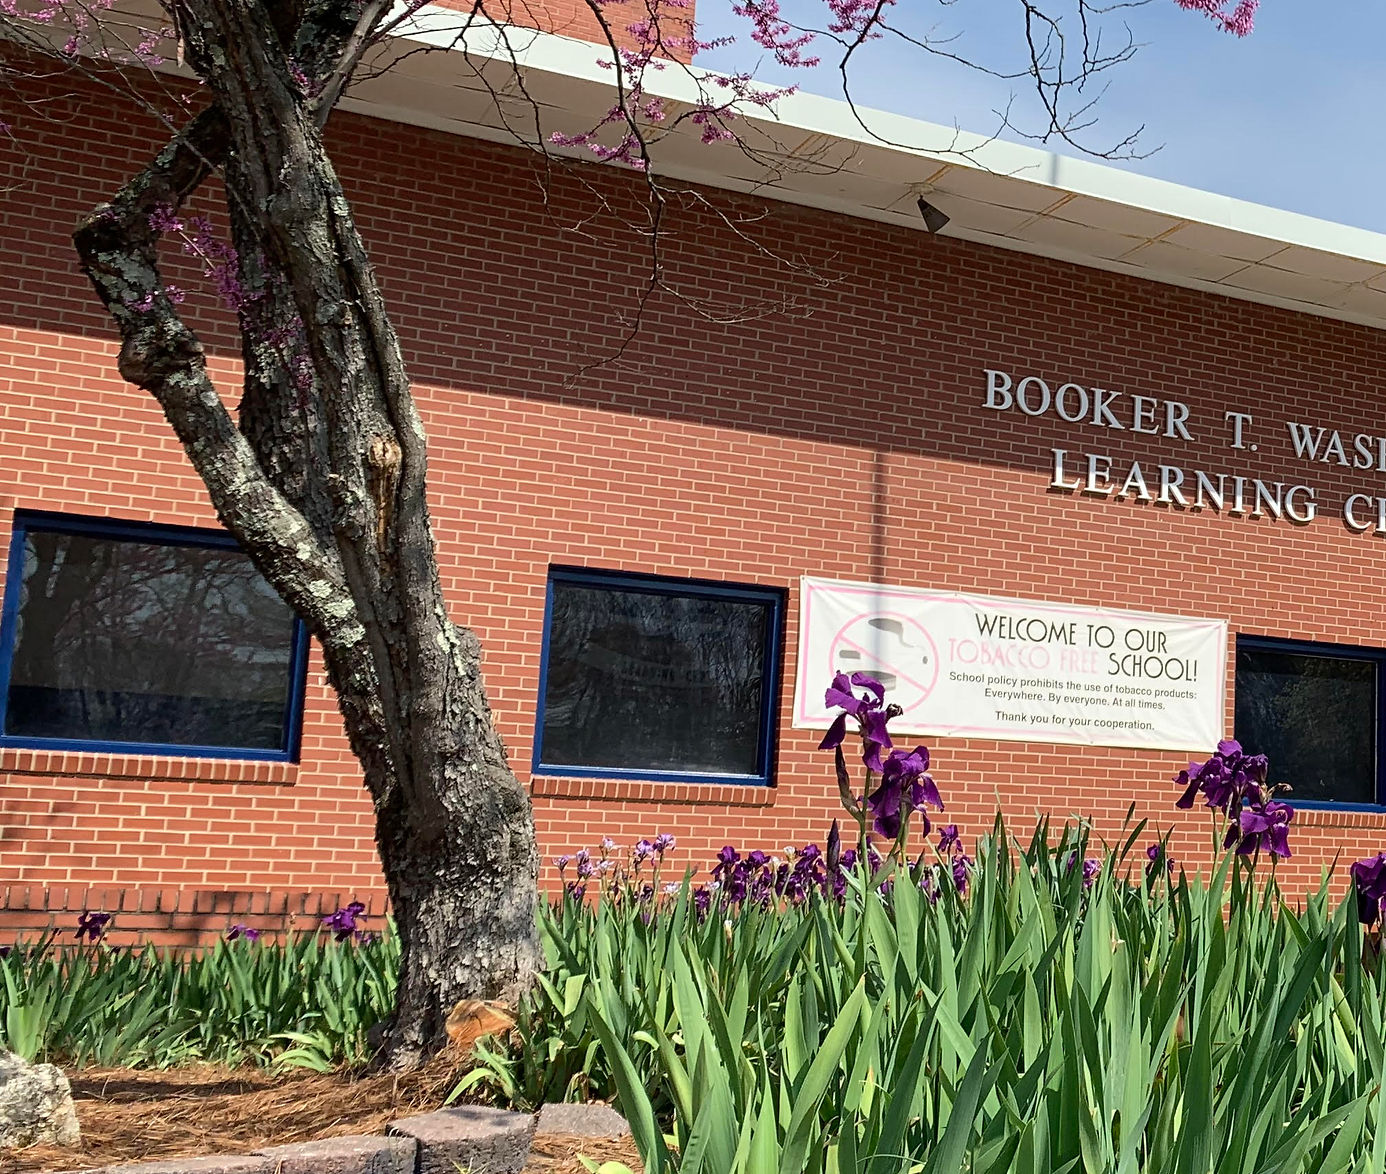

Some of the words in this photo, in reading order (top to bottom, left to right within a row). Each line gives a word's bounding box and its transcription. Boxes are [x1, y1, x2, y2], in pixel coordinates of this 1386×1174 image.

[982, 369, 1194, 441] BOOKER
[1225, 411, 1258, 452] T.
[1050, 449, 1318, 523] LEARNING
[975, 613, 1077, 645] WELCOME
[1087, 625, 1115, 648] TO
[1125, 629, 1167, 653] OUR
[949, 638, 1050, 670] TOBACCO
[1060, 647, 1099, 674] FREE
[1108, 653, 1197, 682] SCHOOL!
[949, 671, 985, 683] School
[987, 675, 1018, 688] policy
[1020, 678, 1064, 689] prohibits
[1066, 681, 1082, 691] the
[1084, 684, 1101, 692] use
[1103, 684, 1113, 693] of
[1115, 685, 1152, 696] tobacco
[1154, 689, 1197, 699] products:
[984, 688, 1046, 701] Everywhere.
[1048, 693, 1061, 704] By
[1064, 696, 1110, 706] everyone.
[1112, 697, 1123, 707] At
[1125, 699, 1136, 708] all
[995, 711, 1027, 722] Thank
[1030, 715, 1049, 725] you
[1052, 715, 1066, 725] for
[1069, 717, 1091, 727] your
[1093, 719, 1155, 731] cooperation.
